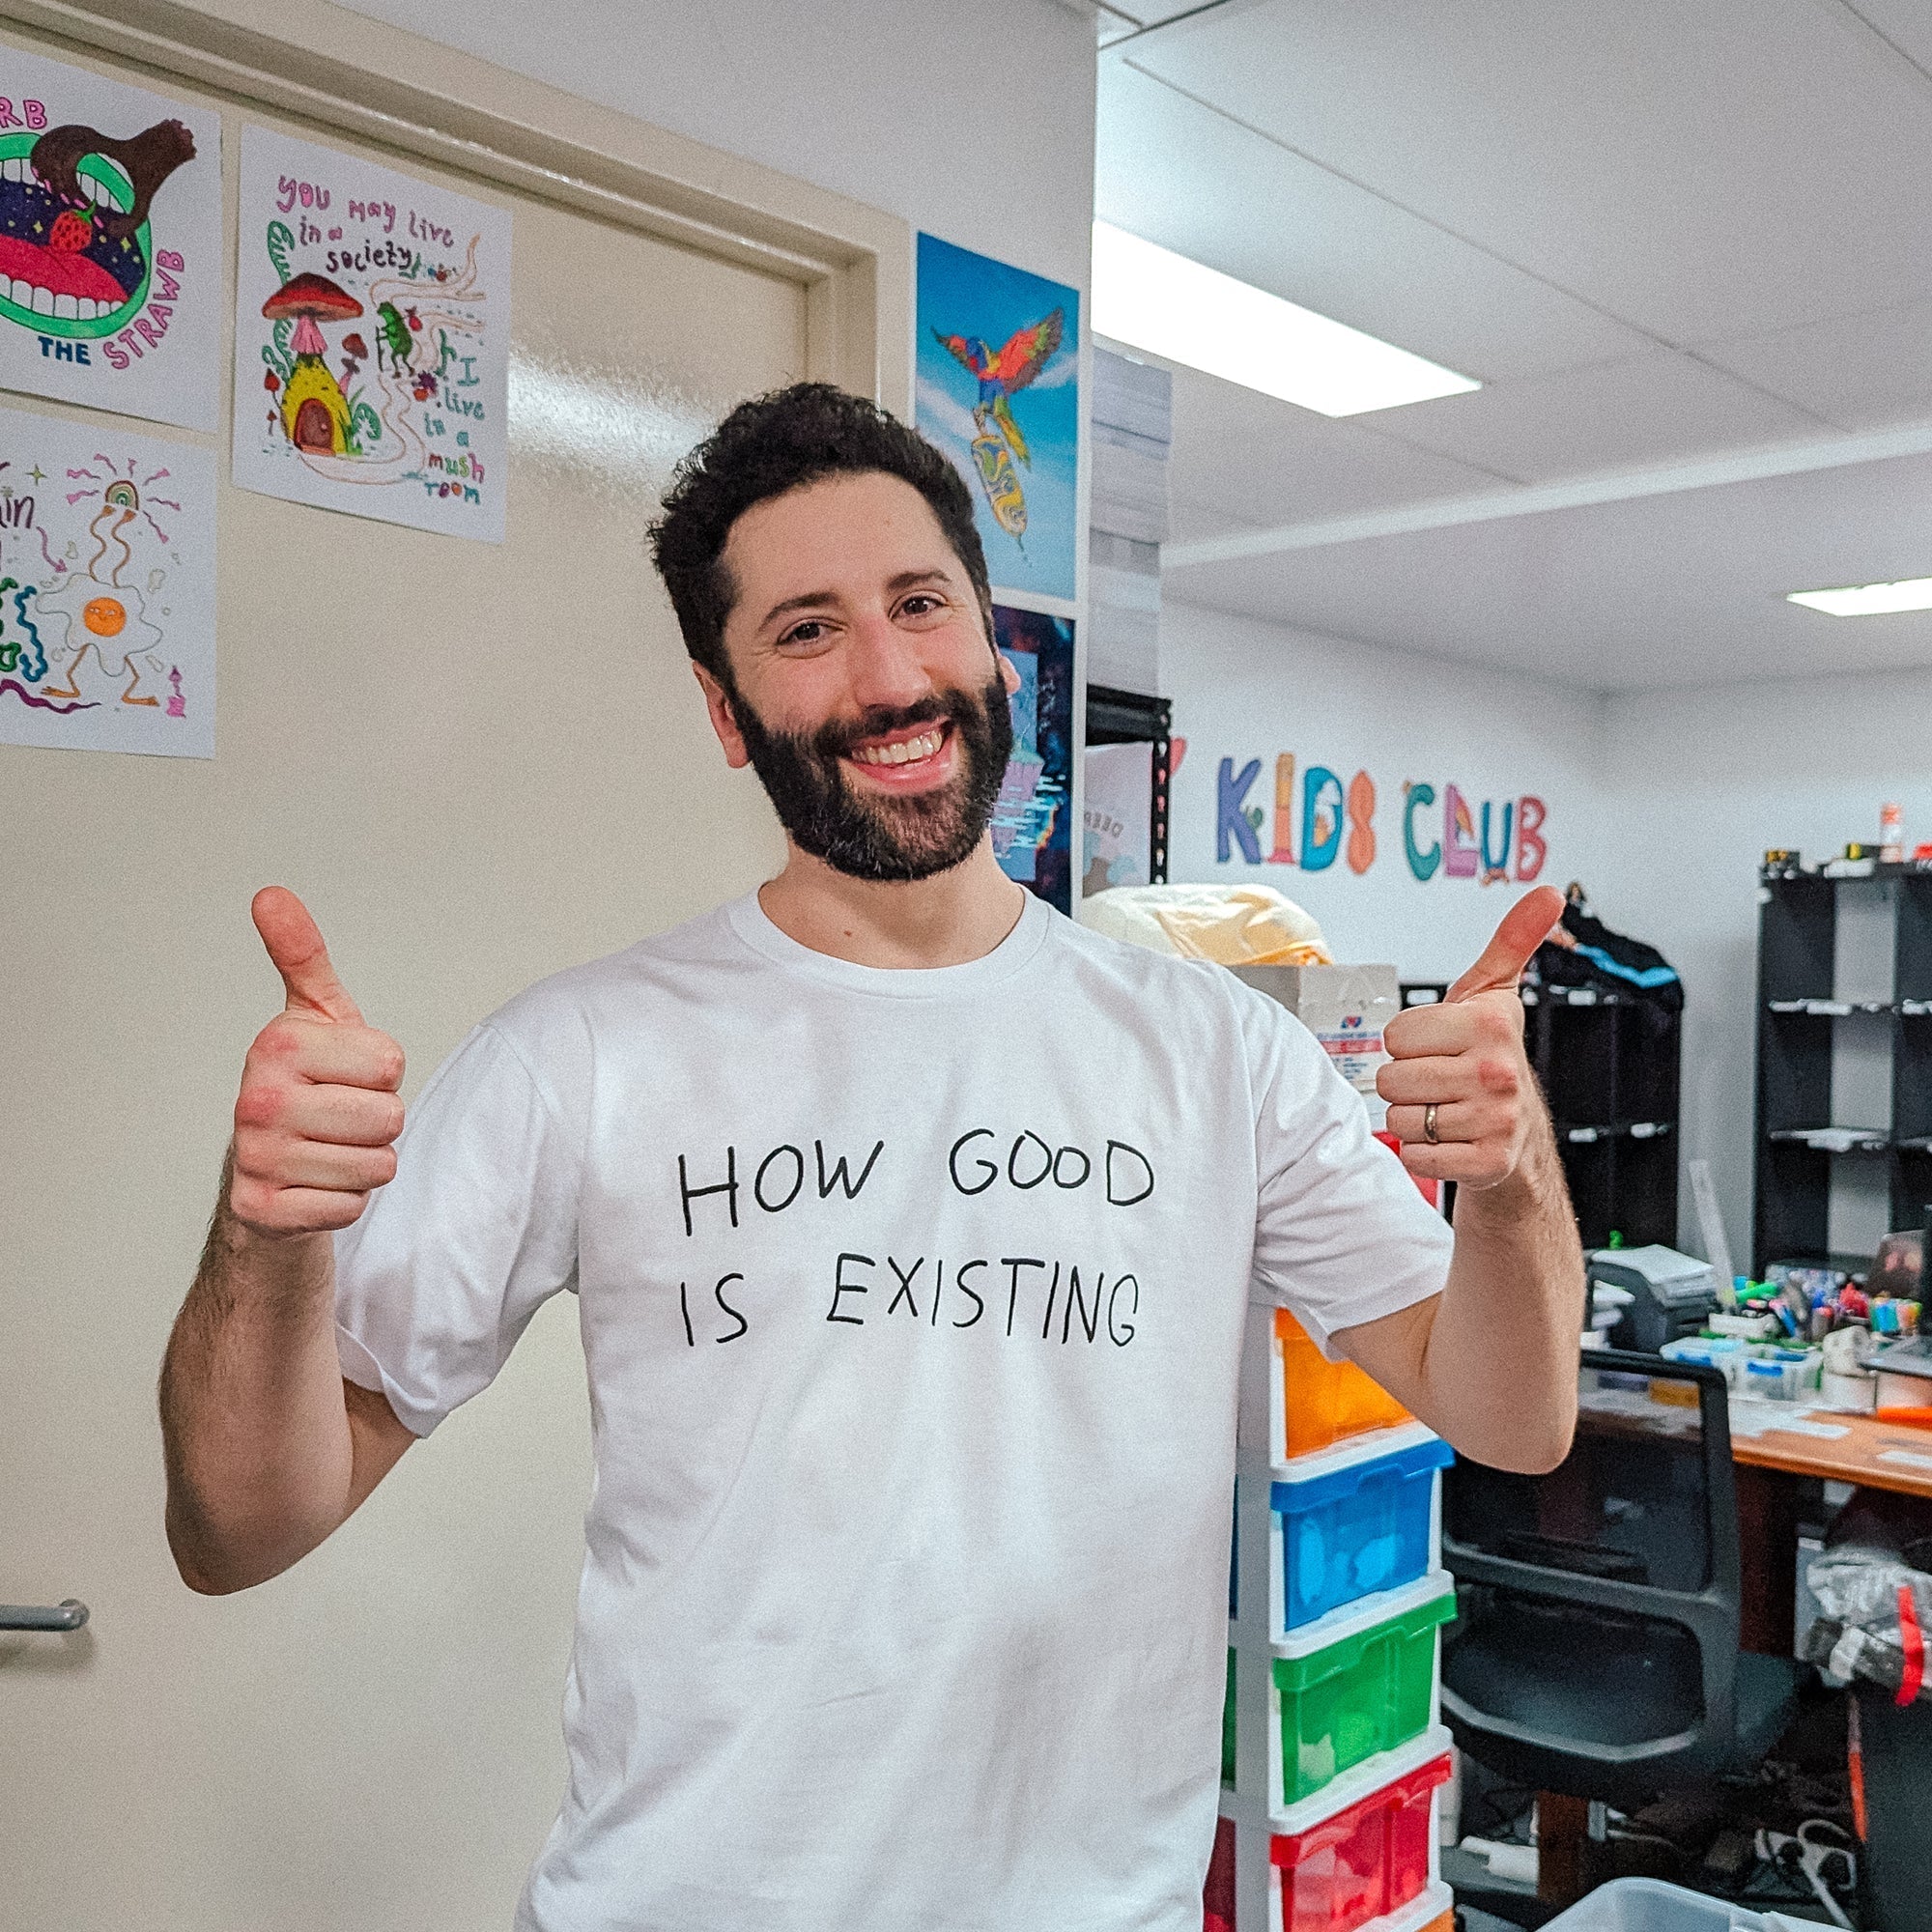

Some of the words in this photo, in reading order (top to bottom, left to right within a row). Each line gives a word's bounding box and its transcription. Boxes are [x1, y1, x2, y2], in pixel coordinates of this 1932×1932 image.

[276, 175, 330, 213] you
[408, 209, 454, 248] live
[299, 215, 321, 246] in
[327, 226, 343, 242] a
[326, 239, 412, 274] society
[38, 335, 92, 366] THE
[102, 249, 185, 370] STRAWB
[457, 356, 481, 387] I
[445, 386, 485, 420] live
[424, 412, 446, 438] in
[456, 431, 469, 447] a
[428, 452, 485, 484] mush
[0, 491, 35, 529] in
[1217, 753, 1377, 875] KIDS
[1403, 781, 1548, 886] CLUB
[678, 1139, 884, 1237] HOW
[949, 1127, 1154, 1207] GOOD
[680, 1272, 749, 1348] IS
[826, 1252, 1139, 1348] EXISTING
